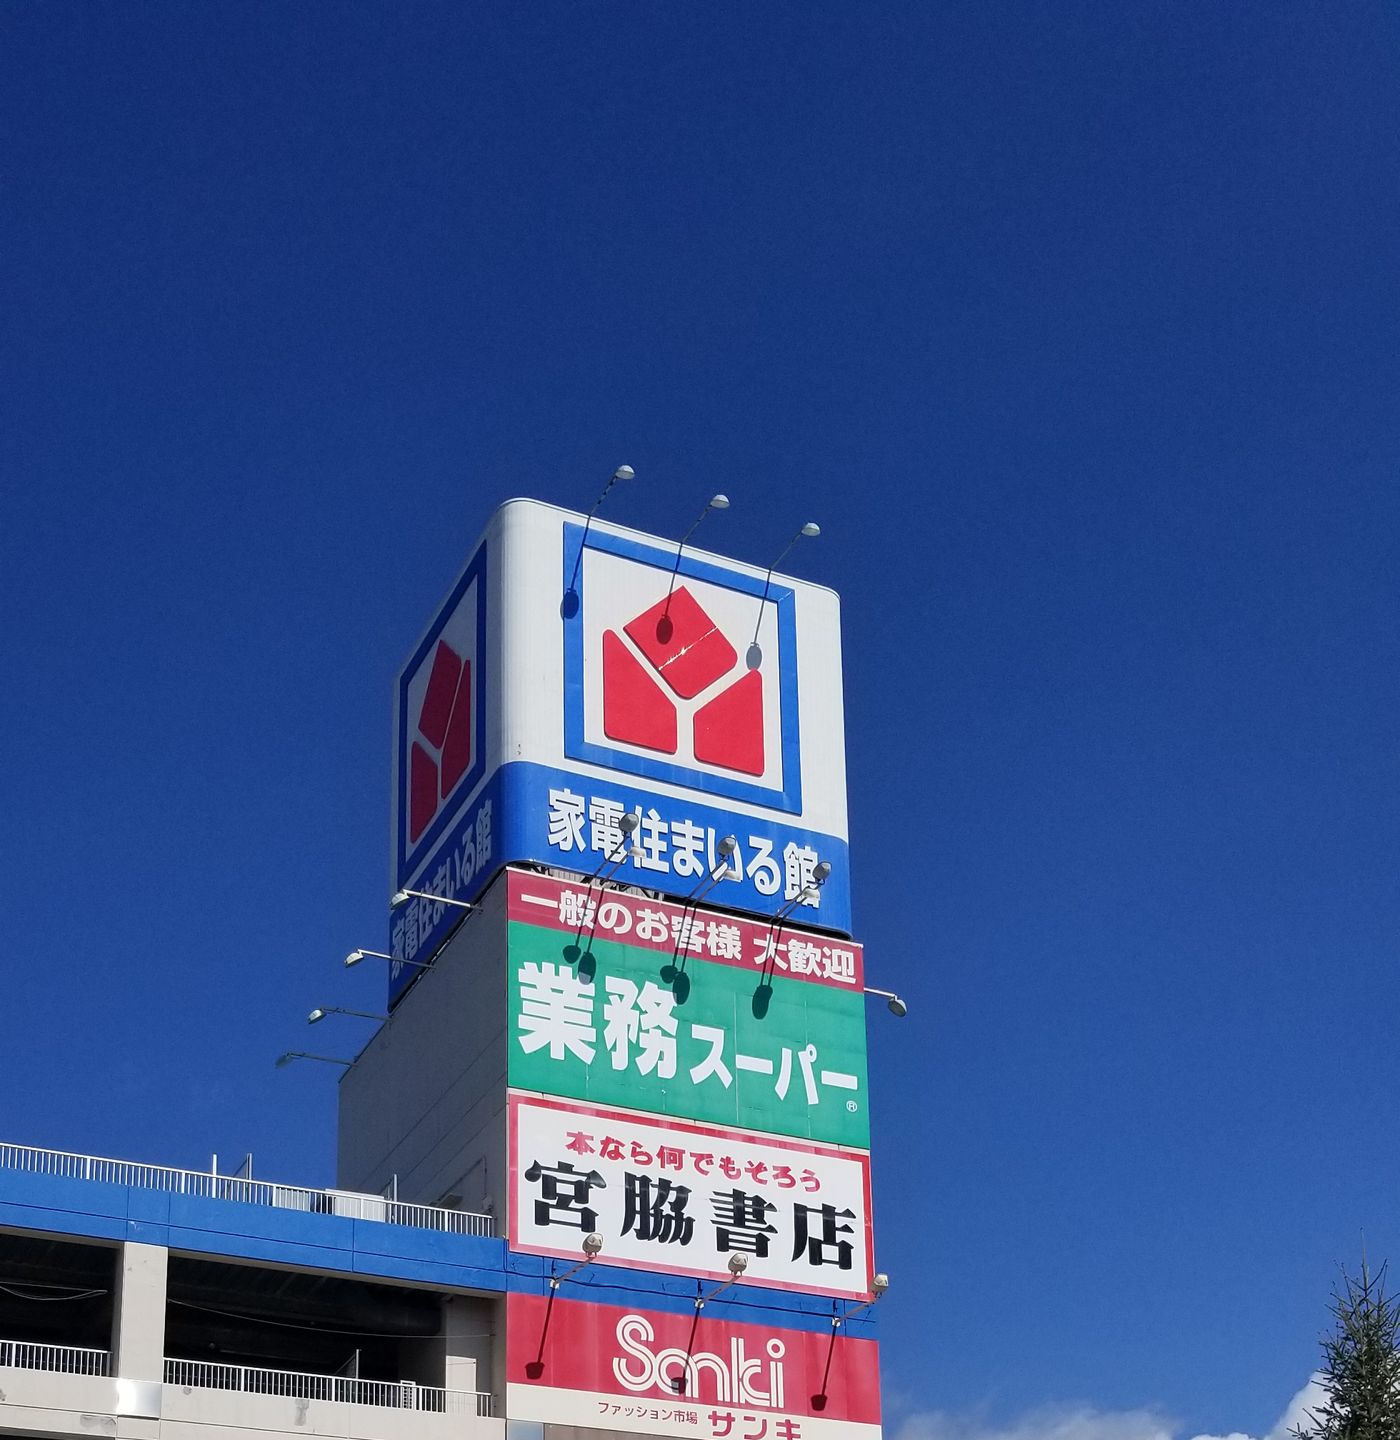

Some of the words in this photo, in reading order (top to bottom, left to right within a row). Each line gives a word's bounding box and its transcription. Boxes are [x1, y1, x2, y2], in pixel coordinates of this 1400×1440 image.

[391, 799, 493, 982] 家電住まいる館
[547, 788, 821, 909] 家電住まいる館
[520, 889, 743, 960] 一般のお客様
[753, 933, 857, 985] 大歓迎
[517, 960, 859, 1106] 業務スーパー
[565, 1130, 821, 1193] 本なら何でもそろう
[524, 1160, 858, 1271] 宮脇書店
[612, 1313, 786, 1409] Sanki
[597, 1401, 699, 1426] ファッション市場
